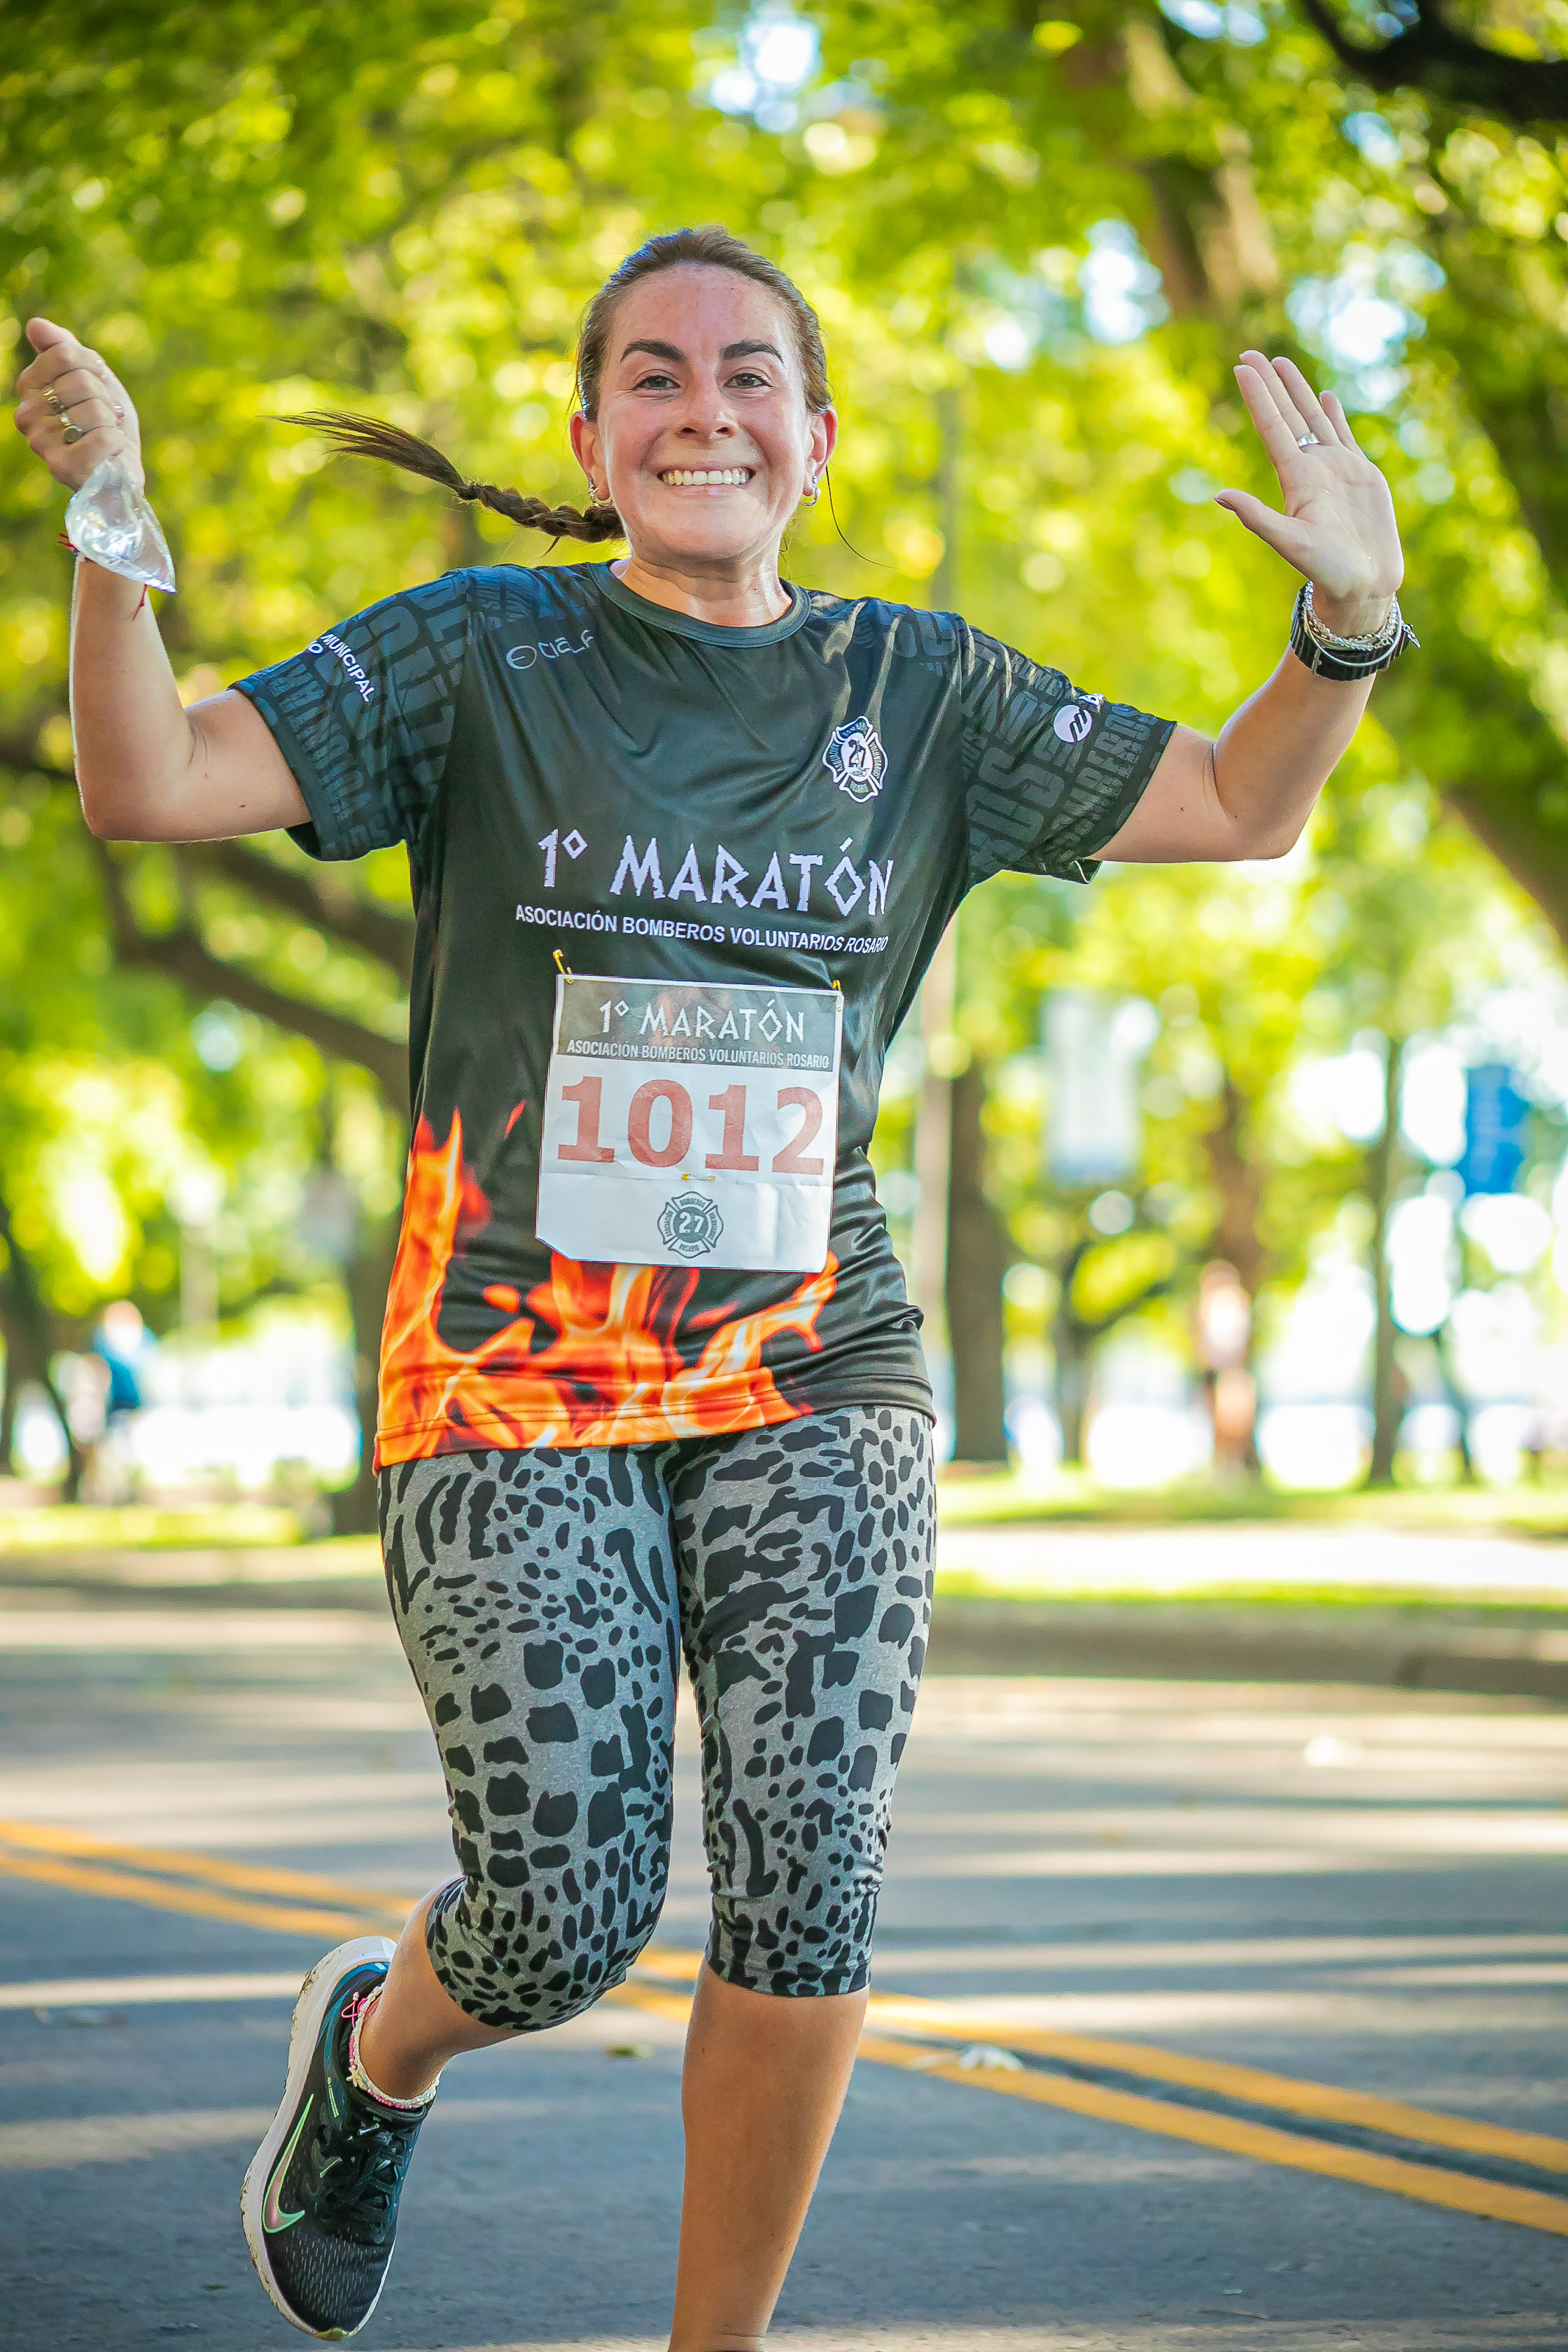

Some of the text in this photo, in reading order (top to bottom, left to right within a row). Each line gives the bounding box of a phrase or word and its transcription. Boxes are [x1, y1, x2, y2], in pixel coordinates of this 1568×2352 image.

[609, 834, 895, 917] MARATÓN
[515, 904, 889, 954] ASOCIACIÓN BOMBEROS VOLUNTARIOS ROSARIO
[639, 999, 804, 1044] MARATÓN
[566, 1039, 830, 1069] ASOCIACIÓN BOMBEROS VOLUNTARIOS ROSARIO
[557, 1075, 824, 1175] 1012
[678, 1211, 705, 1233] 27
